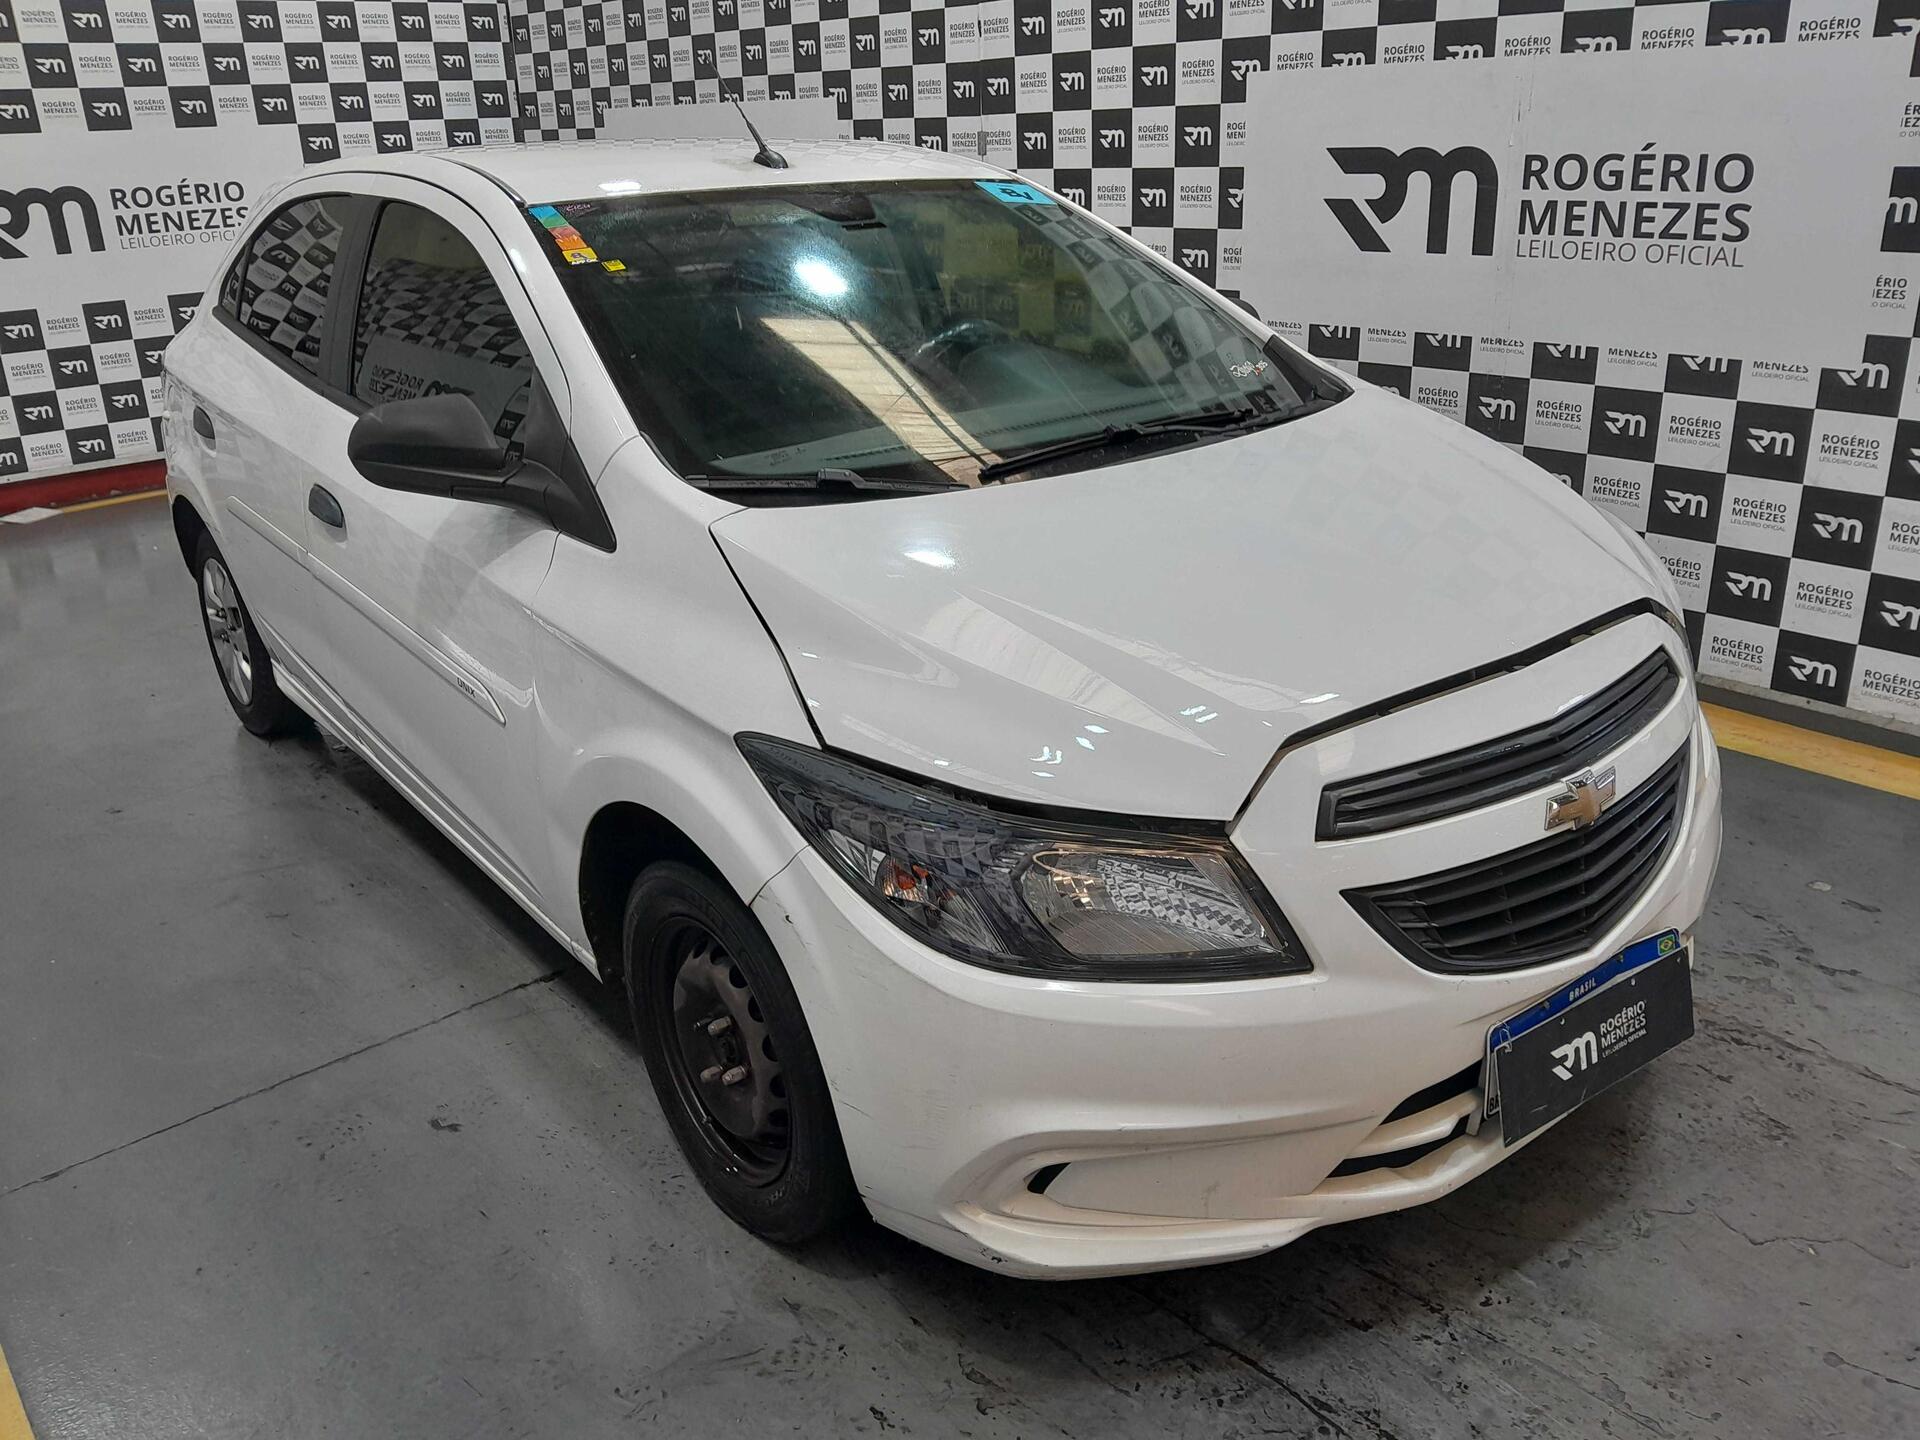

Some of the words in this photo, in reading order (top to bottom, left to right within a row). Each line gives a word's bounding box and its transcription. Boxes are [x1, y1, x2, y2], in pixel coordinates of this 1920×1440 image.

[1138, 7, 1170, 18] MENEZES
[1057, 16, 1086, 26] MENEZES
[1800, 16, 1861, 32] ROGÉRIO
[950, 30, 975, 38] MENEZES
[984, 25, 1009, 34] MENEZES
[1642, 26, 1694, 40] ROGÉRIO
[824, 41, 846, 49] MENEZES
[884, 36, 908, 44] MENEZES
[1504, 35, 1551, 48] ROGÉRIO
[770, 46, 790, 54] MENEZES
[1384, 43, 1424, 56] ROGÉRIO
[1277, 50, 1313, 62] ROGÉRIO
[1097, 72, 1127, 82] MENEZES
[1182, 67, 1214, 78] MENEZES
[1020, 79, 1047, 88] MENEZES
[856, 90, 878, 98] MENEZES
[918, 87, 942, 95] MENEZES
[952, 139, 976, 147] MENEZES
[1058, 134, 1086, 144] MENEZES
[1138, 132, 1168, 142] MENEZES
[1522, 143, 1754, 193] ROGÉRIO
[110, 178, 244, 210] ROGÉRIO
[1098, 192, 1126, 202] MENEZES
[1180, 193, 1212, 202] MENEZES
[1518, 199, 1752, 242] MENEZES
[120, 234, 195, 250] LEILOEIRO
[1516, 240, 1636, 262] LEILOEIRO
[1644, 244, 1744, 267] OFICIAL
[134, 313, 165, 321] MENEZES
[48, 323, 80, 332] MENEZES
[101, 358, 132, 366] MENEZES
[12, 369, 45, 377] MENEZES
[1418, 386, 1458, 398] ROGÉRIO
[66, 404, 98, 412] MENEZES
[1418, 396, 1458, 408] MENEZES
[1536, 400, 1582, 412] ROGÉRIO
[1536, 410, 1582, 422] MENEZES
[1670, 416, 1722, 430] ROGÉRIO
[1669, 426, 1720, 440] MENEZES
[118, 436, 148, 444] MENEZES
[1822, 434, 1880, 449] ROGÉRIO
[31, 448, 63, 458] MENEZES
[1820, 444, 1878, 460] MENEZES
[1594, 476, 1641, 490] ROGÉRIO
[1592, 486, 1640, 500] MENEZES
[1734, 498, 1786, 513] ROGÉRIO
[1732, 508, 1786, 524] MENEZES
[1660, 556, 1702, 571] OGÉRIO
[1668, 568, 1700, 580] NEZES
[1798, 582, 1854, 600] ROGÉRIO
[1796, 592, 1852, 610] MENEZES
[1712, 636, 1764, 654] ROGÉRIO
[1711, 646, 1763, 664] MENEZES
[1864, 670, 1920, 688] ROGÉRIO
[1862, 680, 1920, 700] MENEZES
[1569, 977, 1597, 1000] BRASIL
[1600, 1001, 1646, 1035] ROGÉRIO
[1602, 1014, 1646, 1048] MENEZES
